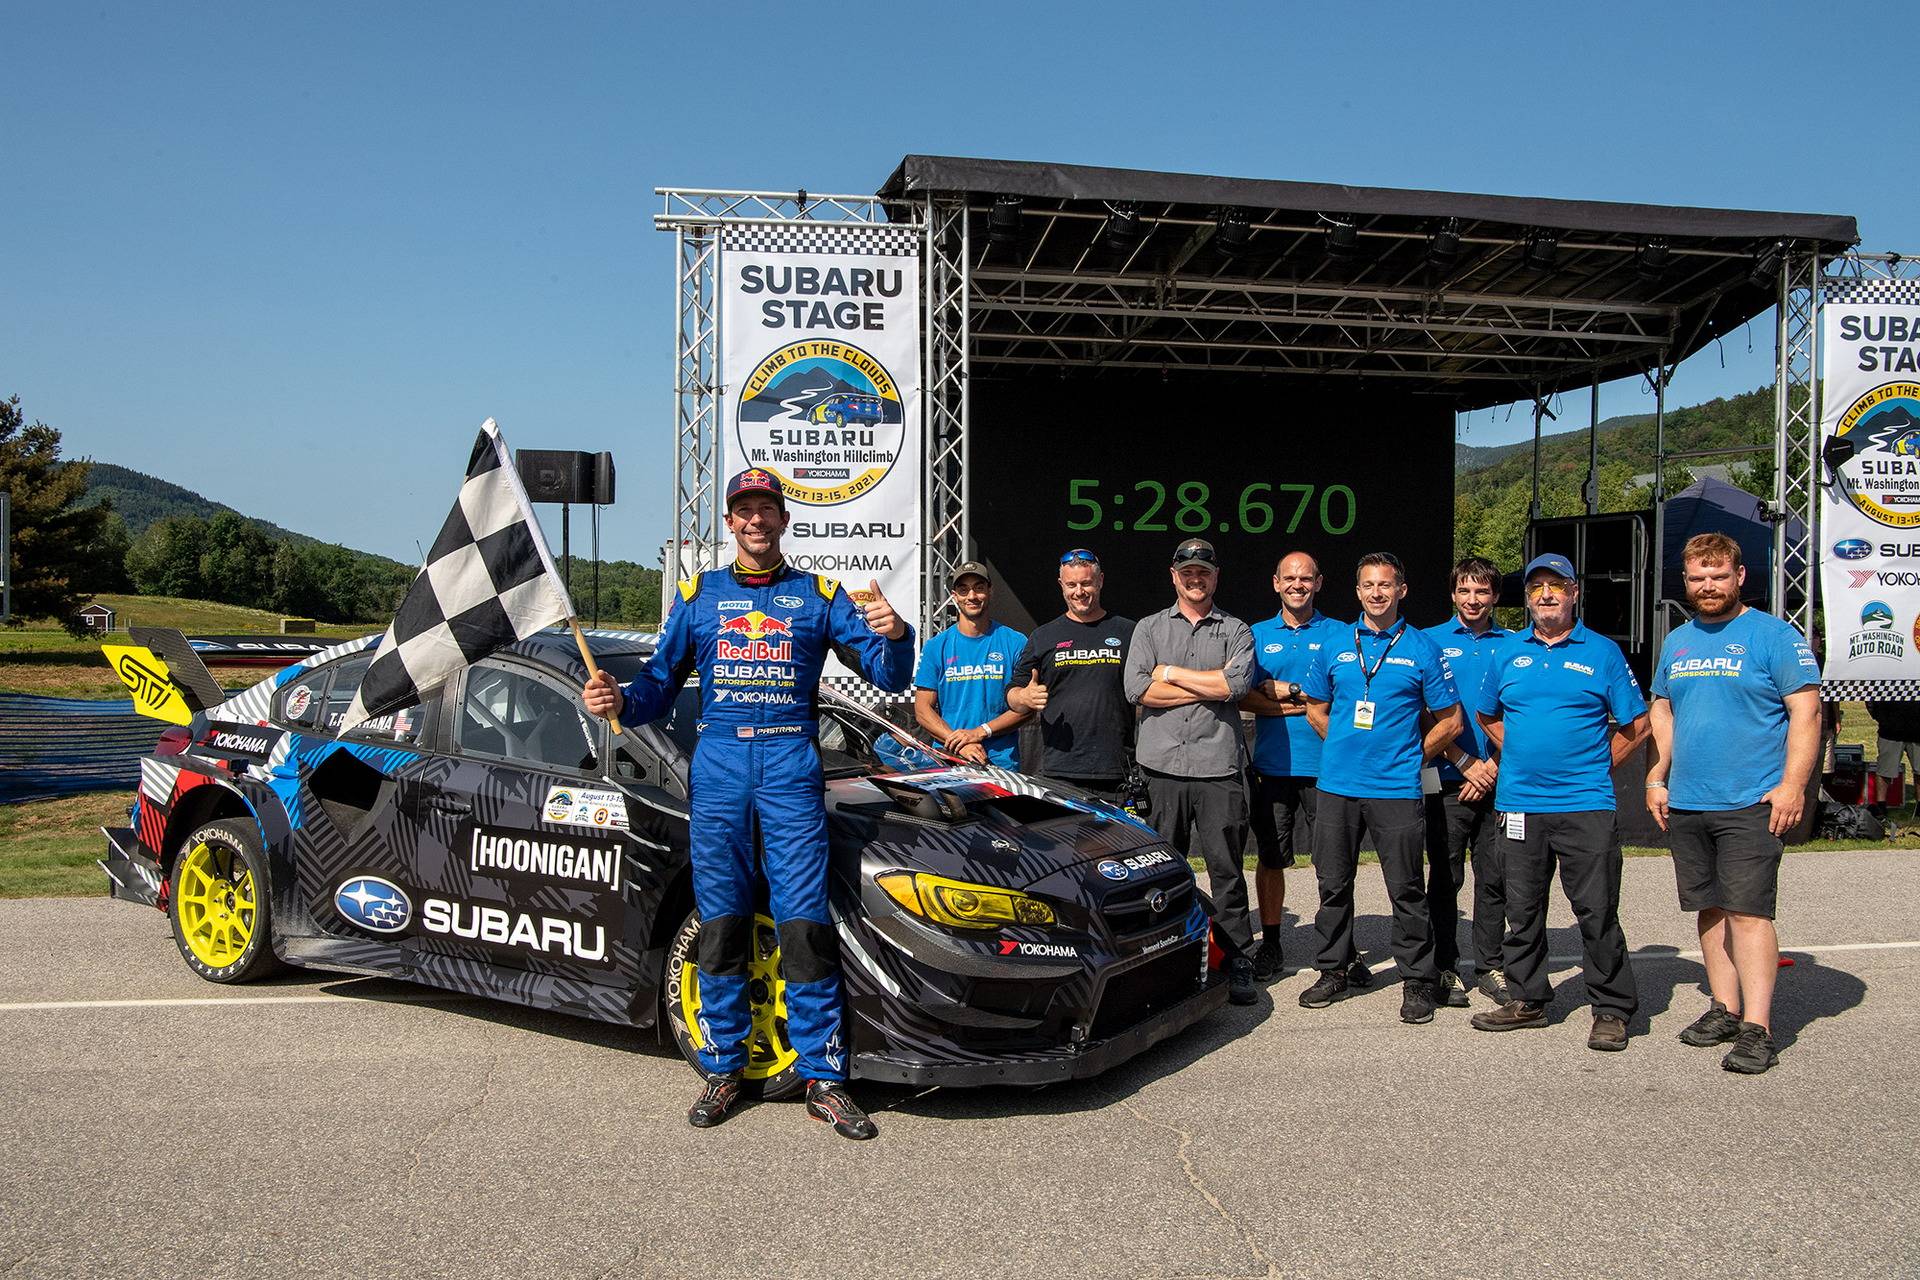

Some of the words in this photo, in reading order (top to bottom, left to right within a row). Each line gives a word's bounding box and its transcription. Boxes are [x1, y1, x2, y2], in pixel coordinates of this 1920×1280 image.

[740, 265, 902, 298] SUBARU
[762, 300, 884, 330] STAGE
[1858, 346, 1920, 372] STA
[751, 355, 787, 392] CLIMB
[788, 346, 807, 360] TO
[811, 343, 840, 356] THE
[843, 347, 891, 394] CLOUDS
[1842, 395, 1875, 427] CLIMB
[1877, 387, 1892, 399] TO
[1897, 385, 1919, 398] THE
[769, 429, 874, 447] SUBARU
[751, 449, 769, 462] Mt.
[773, 449, 840, 465] Washington
[843, 450, 894, 463] Hillclimb
[807, 470, 848, 478] YOKOHAMA
[1862, 461, 1920, 475] SUBA
[849, 474, 875, 494] 2021
[1846, 478, 1862, 490] Mt.
[1865, 478, 1920, 492] Washington
[1067, 479, 1356, 535] 5:28.670
[1860, 499, 1894, 525] AUGUST
[792, 522, 905, 538] SUBARU
[788, 555, 893, 571] YOKOHAMA
[1862, 632, 1904, 645] WASHINGTON
[717, 639, 754, 661] Red
[755, 640, 792, 662] Bull
[1055, 649, 1121, 662] SUBARU
[1849, 642, 1874, 659] AUTO
[1878, 641, 1903, 658] ROAD
[713, 664, 796, 679] SUBARU
[945, 664, 1004, 677] SUBARU
[1670, 657, 1743, 674] SUBARU
[713, 678, 776, 687] MOTORSPORTS
[730, 690, 797, 704] YOKOHAMA
[757, 726, 802, 735] PASTRANA
[213, 732, 268, 754] YOKOHAMA
[581, 792, 605, 802] August
[192, 828, 244, 856] YOKOHAMA
[1123, 850, 1174, 871] SUBARU
[422, 899, 605, 961] SUBARU
[1018, 942, 1078, 958] YOKOHAMA
[668, 918, 702, 1008] YOKOHAM
